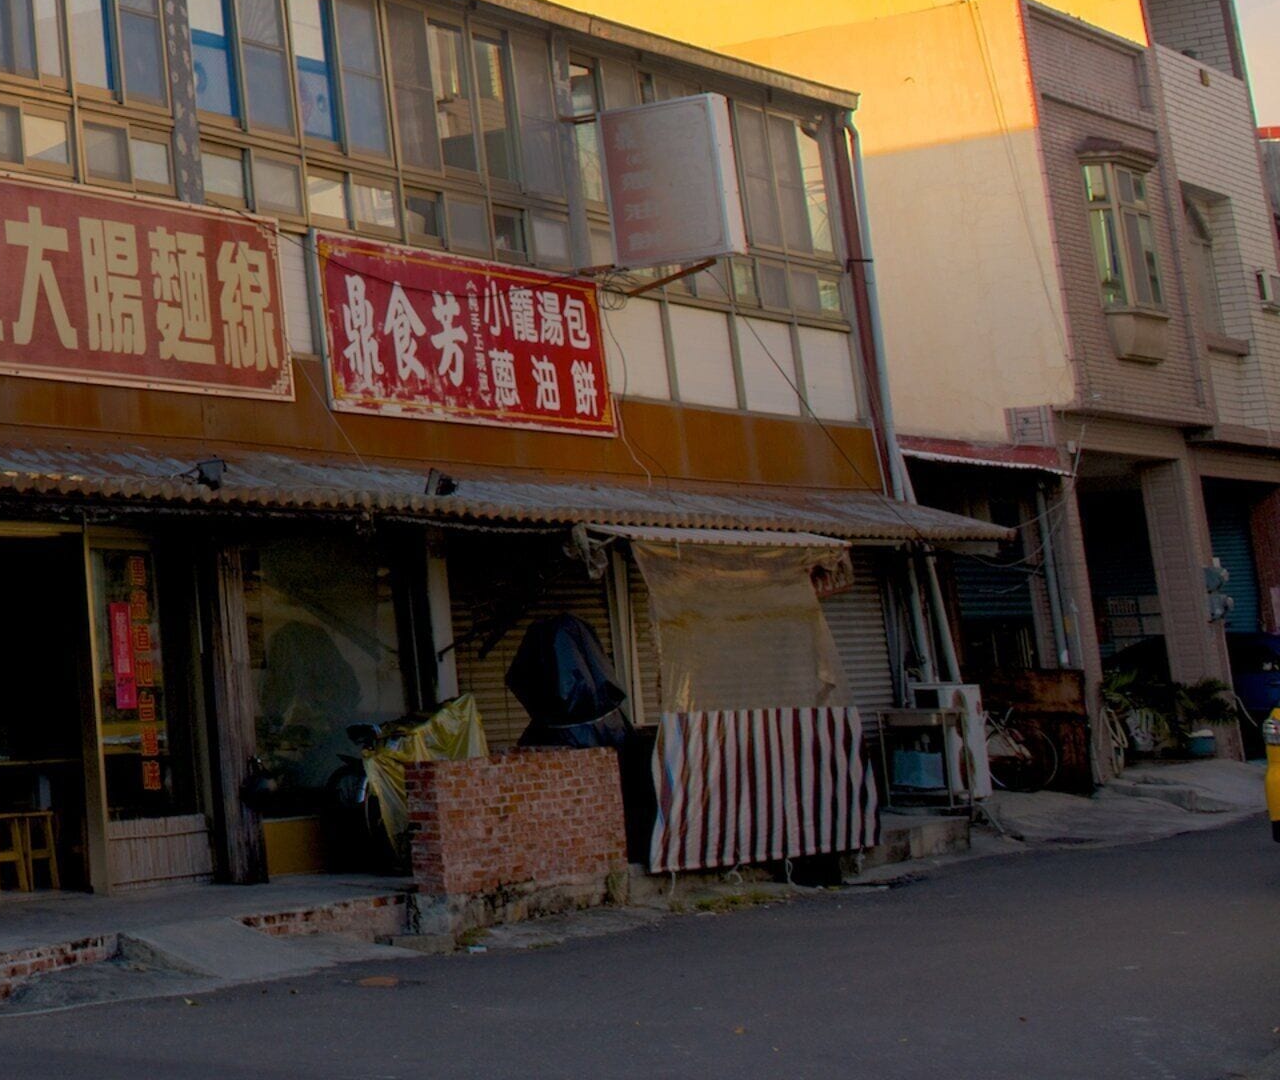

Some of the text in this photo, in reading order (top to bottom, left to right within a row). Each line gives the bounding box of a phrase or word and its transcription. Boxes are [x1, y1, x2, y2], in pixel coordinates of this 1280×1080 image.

[342, 274, 469, 390] 鼎食芳
[484, 279, 591, 350] 小籠湯包
